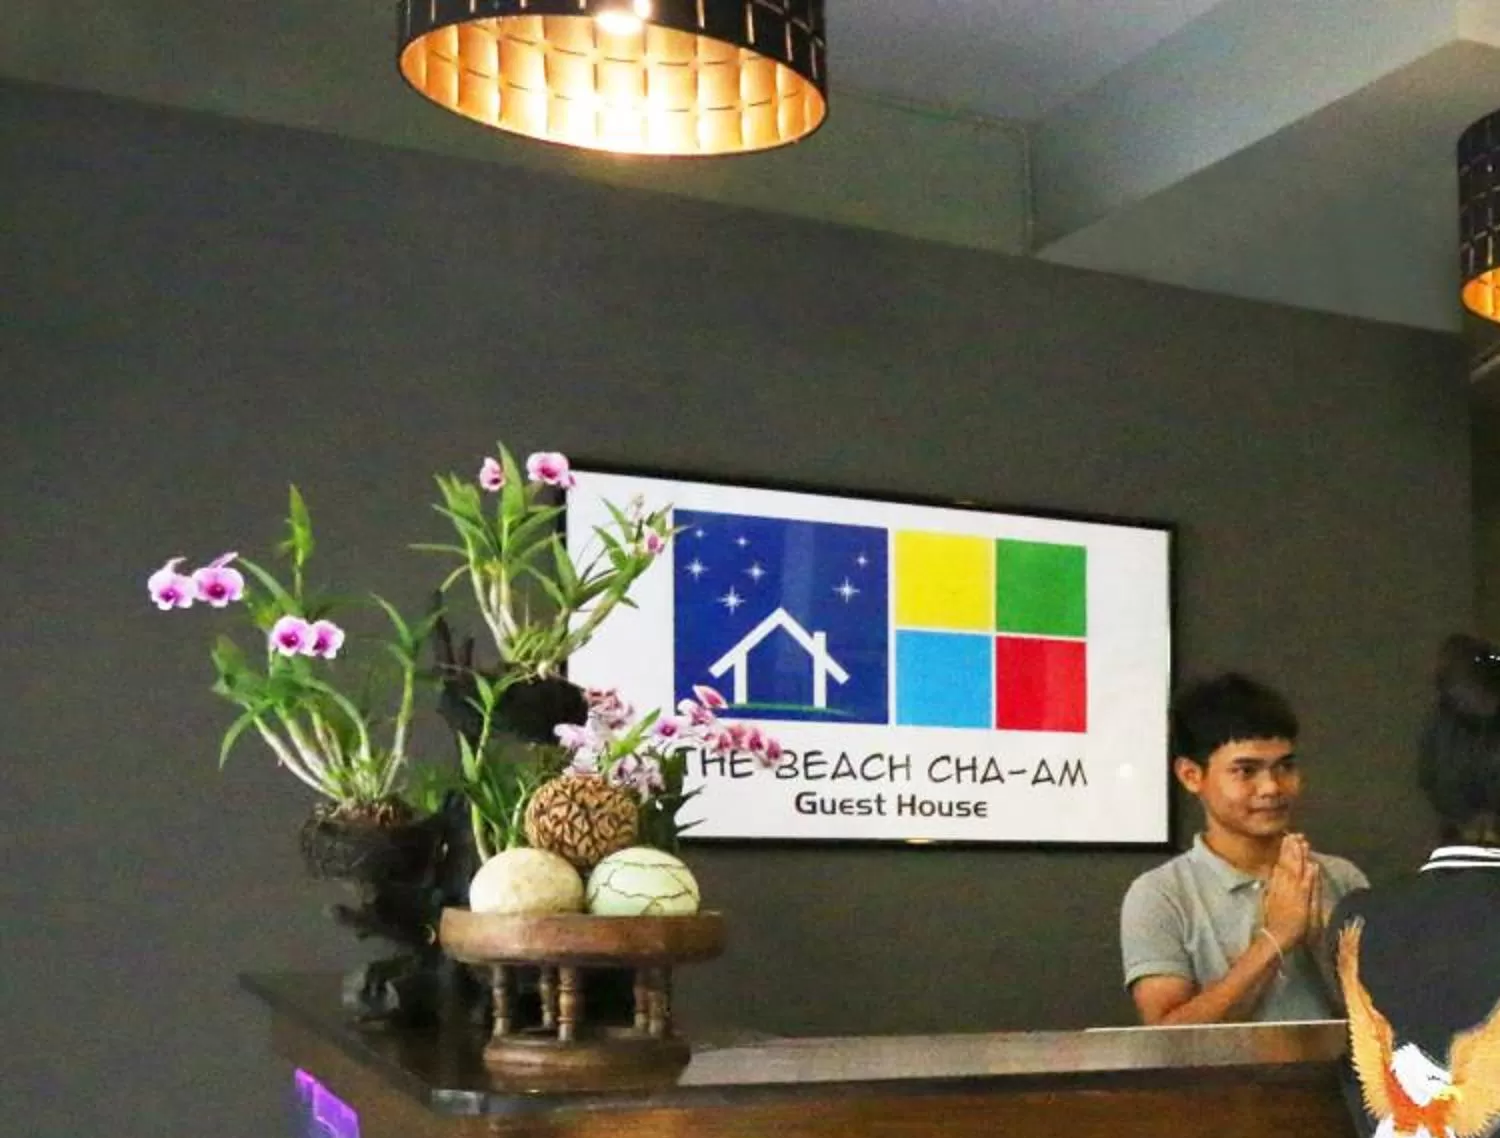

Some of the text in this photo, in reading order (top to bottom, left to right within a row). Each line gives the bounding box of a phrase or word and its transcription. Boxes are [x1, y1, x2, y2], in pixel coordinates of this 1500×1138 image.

[675, 746, 1088, 787] THE BEACH CHA-AM
[795, 791, 988, 818] Guest House
